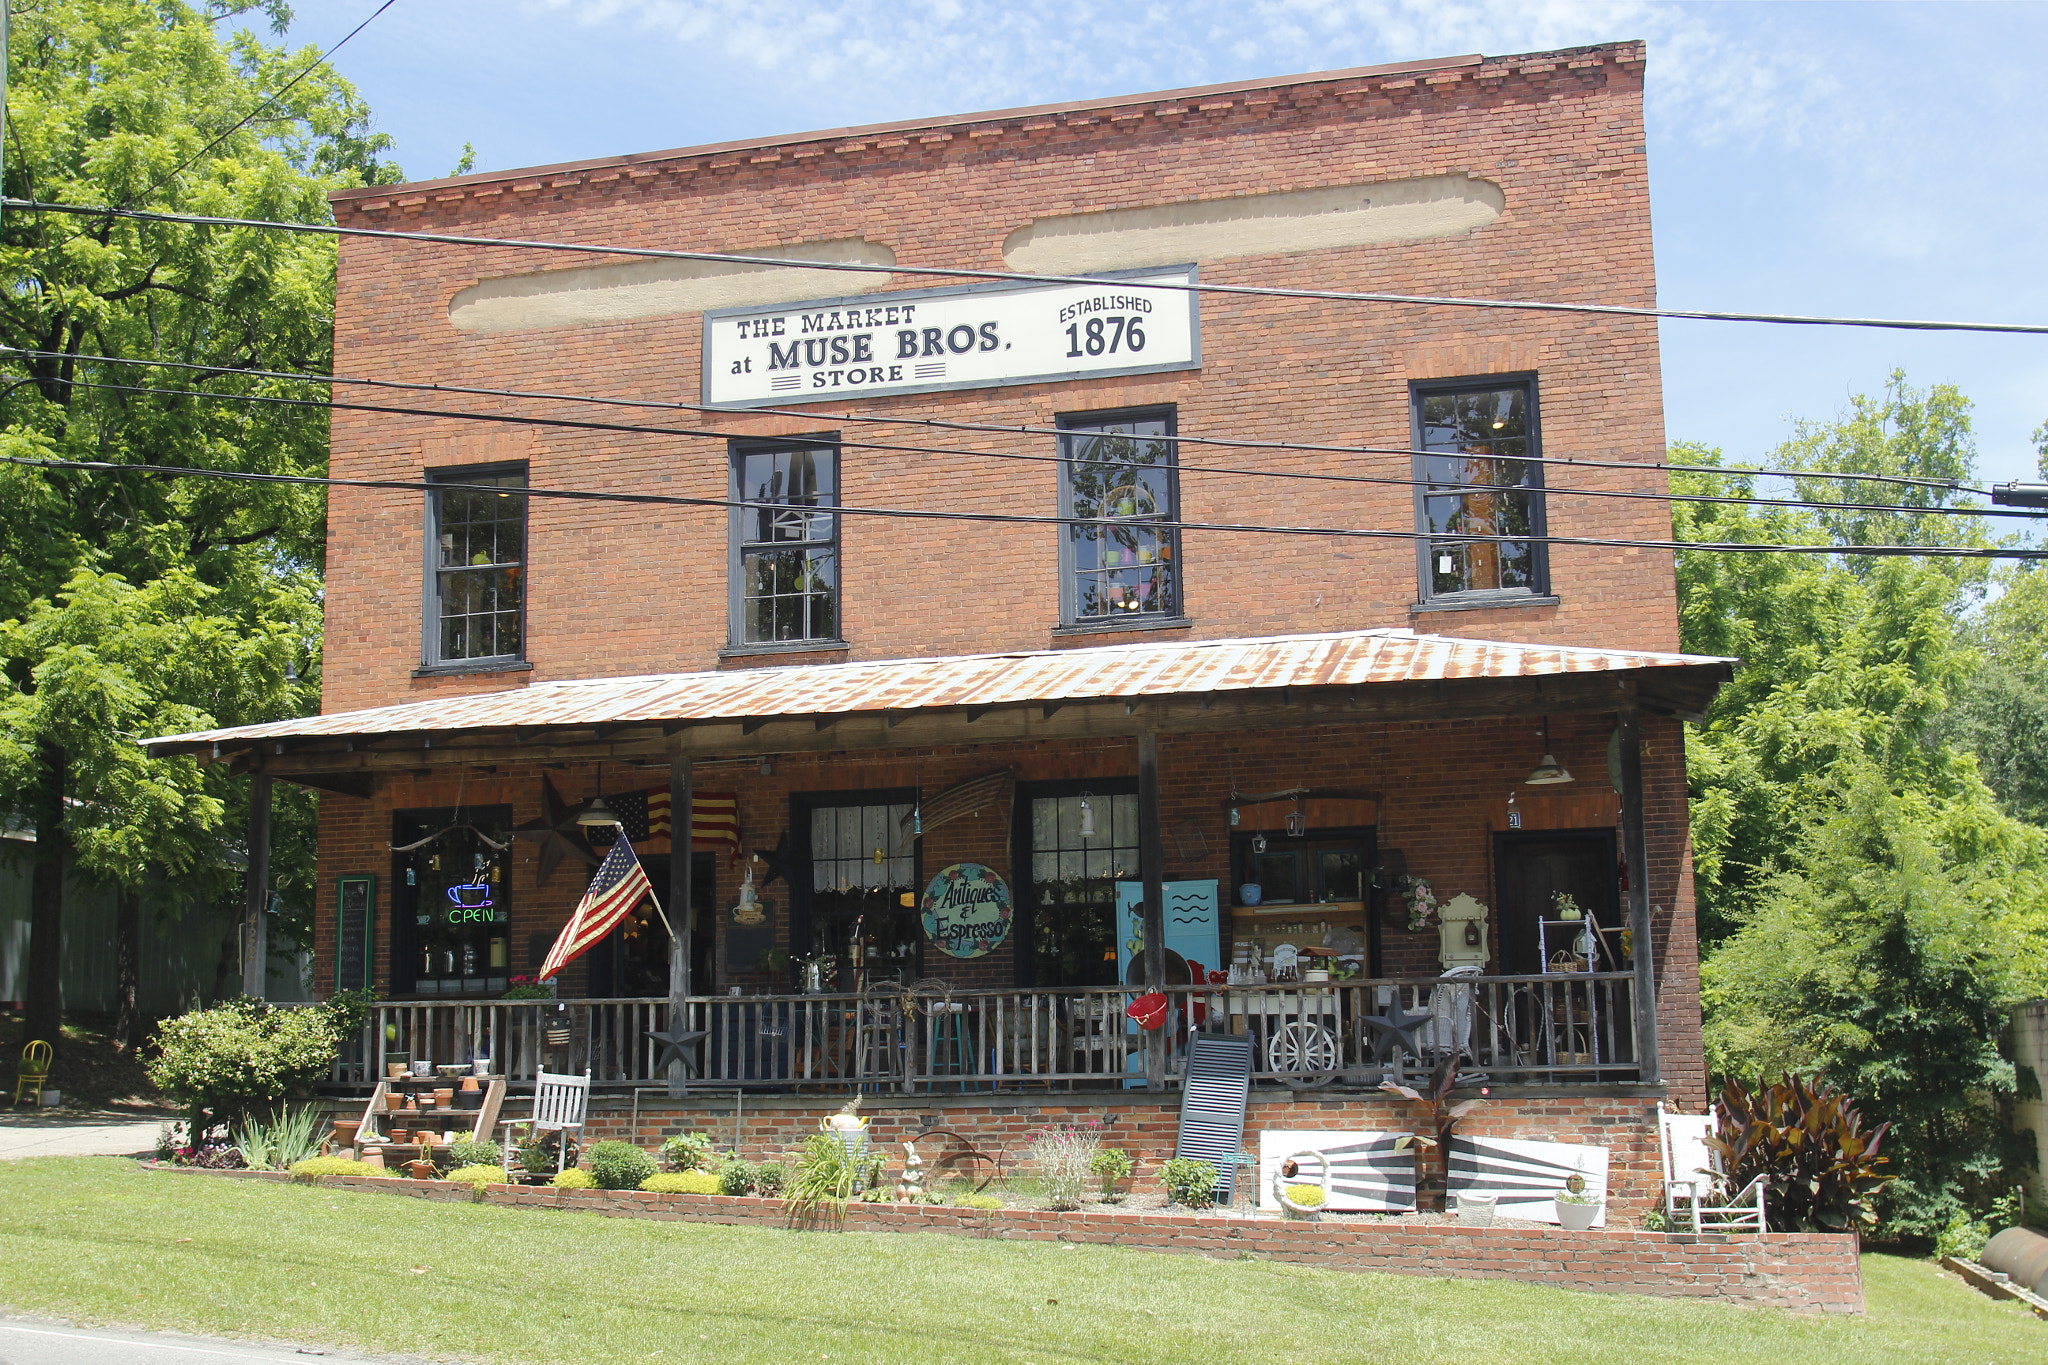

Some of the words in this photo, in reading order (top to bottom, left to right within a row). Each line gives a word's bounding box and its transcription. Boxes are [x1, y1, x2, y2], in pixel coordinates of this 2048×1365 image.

[737, 317, 785, 340] THE
[801, 305, 915, 334] MARKET
[1059, 295, 1153, 324] ESTABLISHED
[731, 356, 752, 375] at
[767, 333, 873, 371] MUSE
[895, 320, 1011, 360] BROS.
[1065, 316, 1146, 358] 1876
[812, 365, 903, 388] STORE
[938, 876, 1001, 914] Antiques
[936, 915, 1004, 951] Espresso
